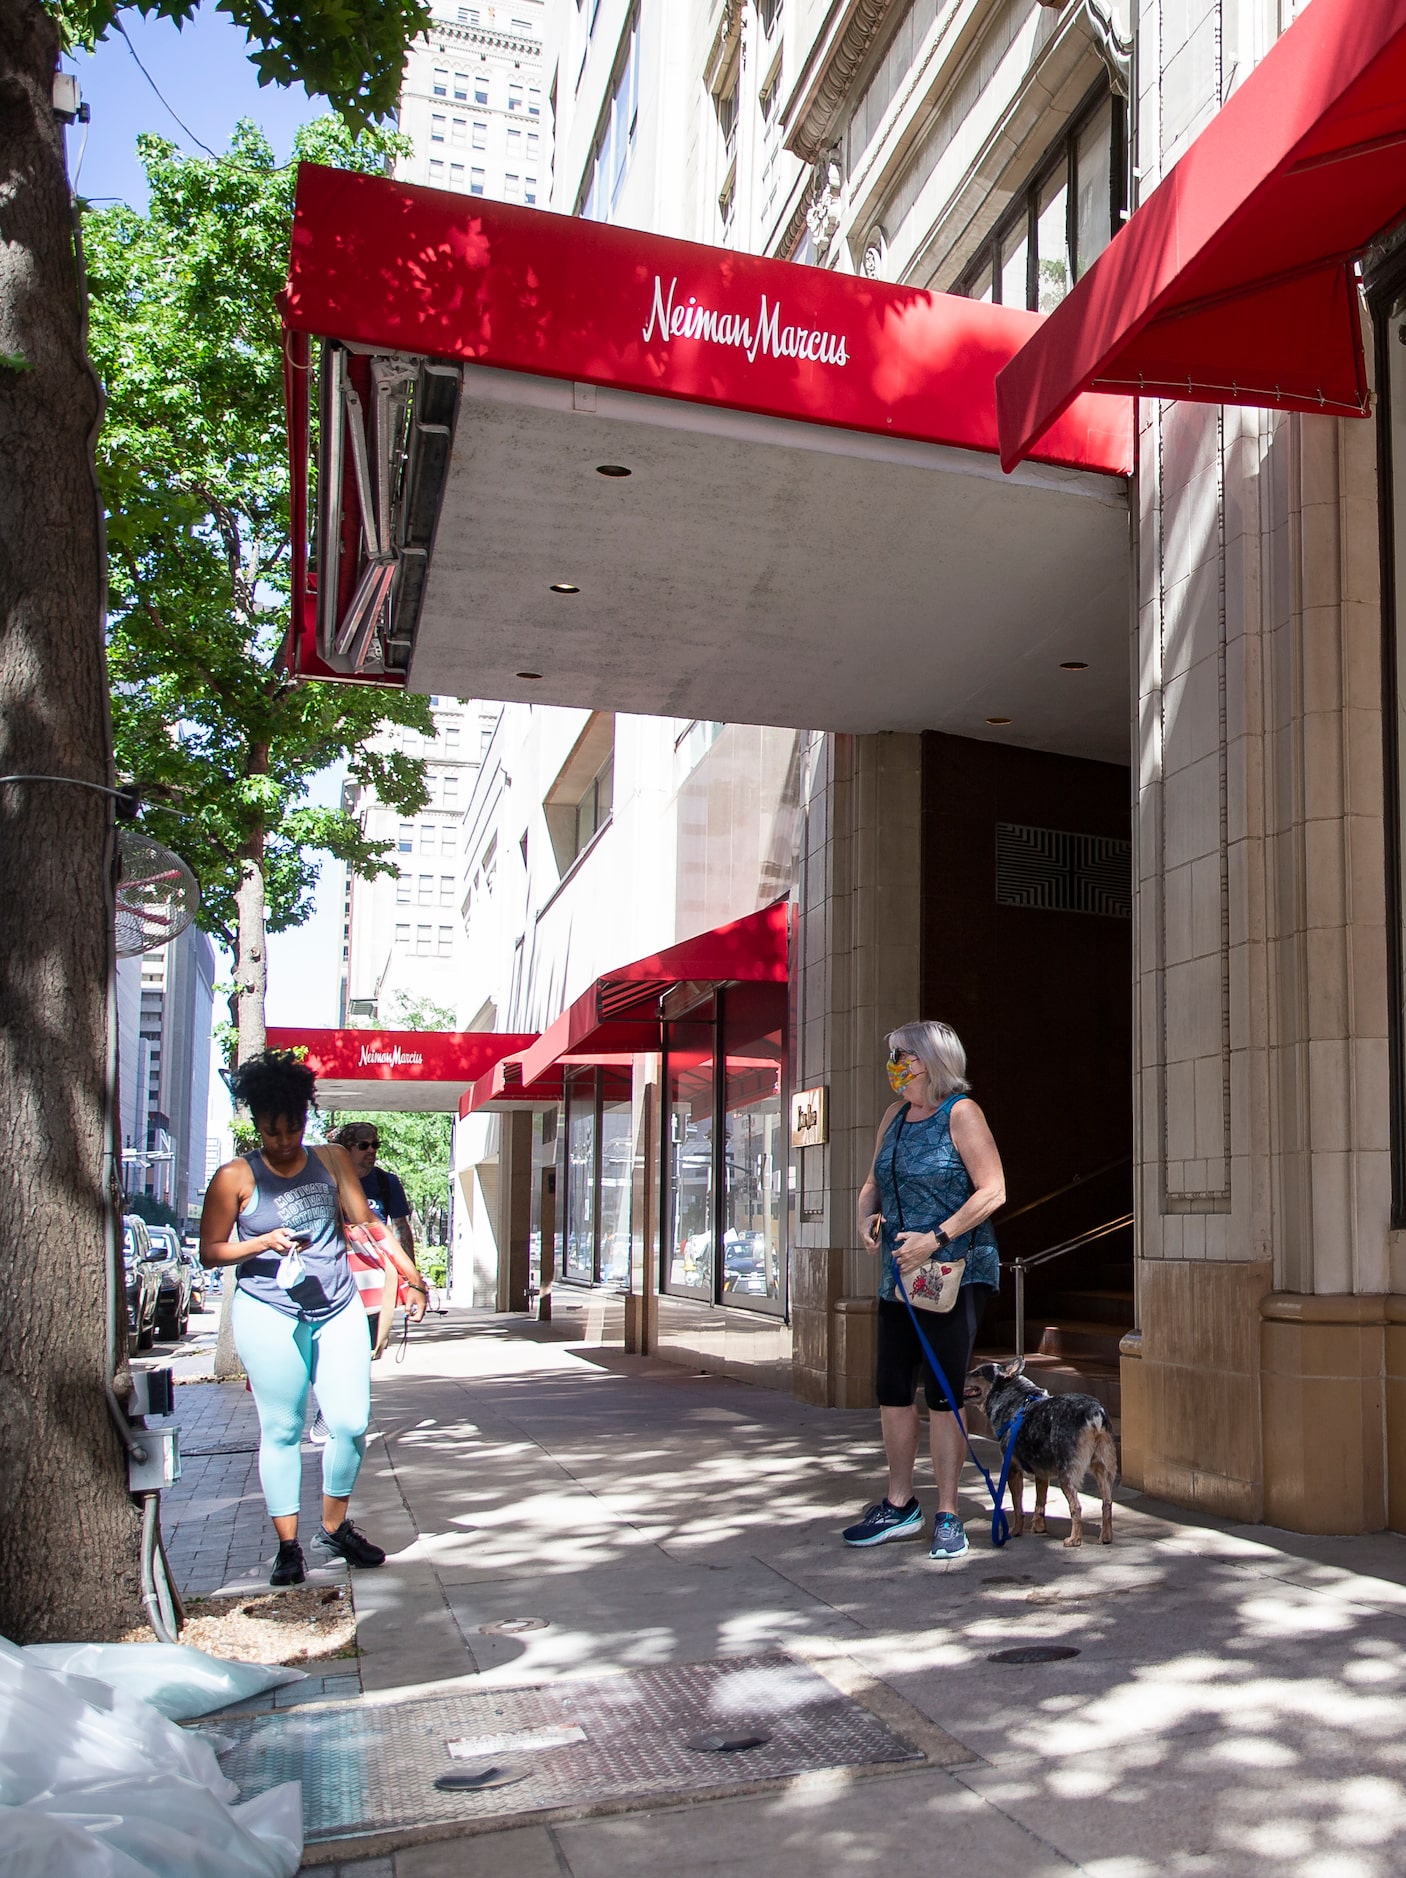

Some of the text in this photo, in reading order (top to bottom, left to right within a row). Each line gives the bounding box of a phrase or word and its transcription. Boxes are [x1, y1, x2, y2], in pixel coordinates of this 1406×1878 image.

[643, 276, 850, 366] Neiman Marcus
[358, 1045, 423, 1068] Neiman Marcus
[274, 1182, 329, 1208] MOTIVATE
[278, 1193, 334, 1221] MOTIVATE
